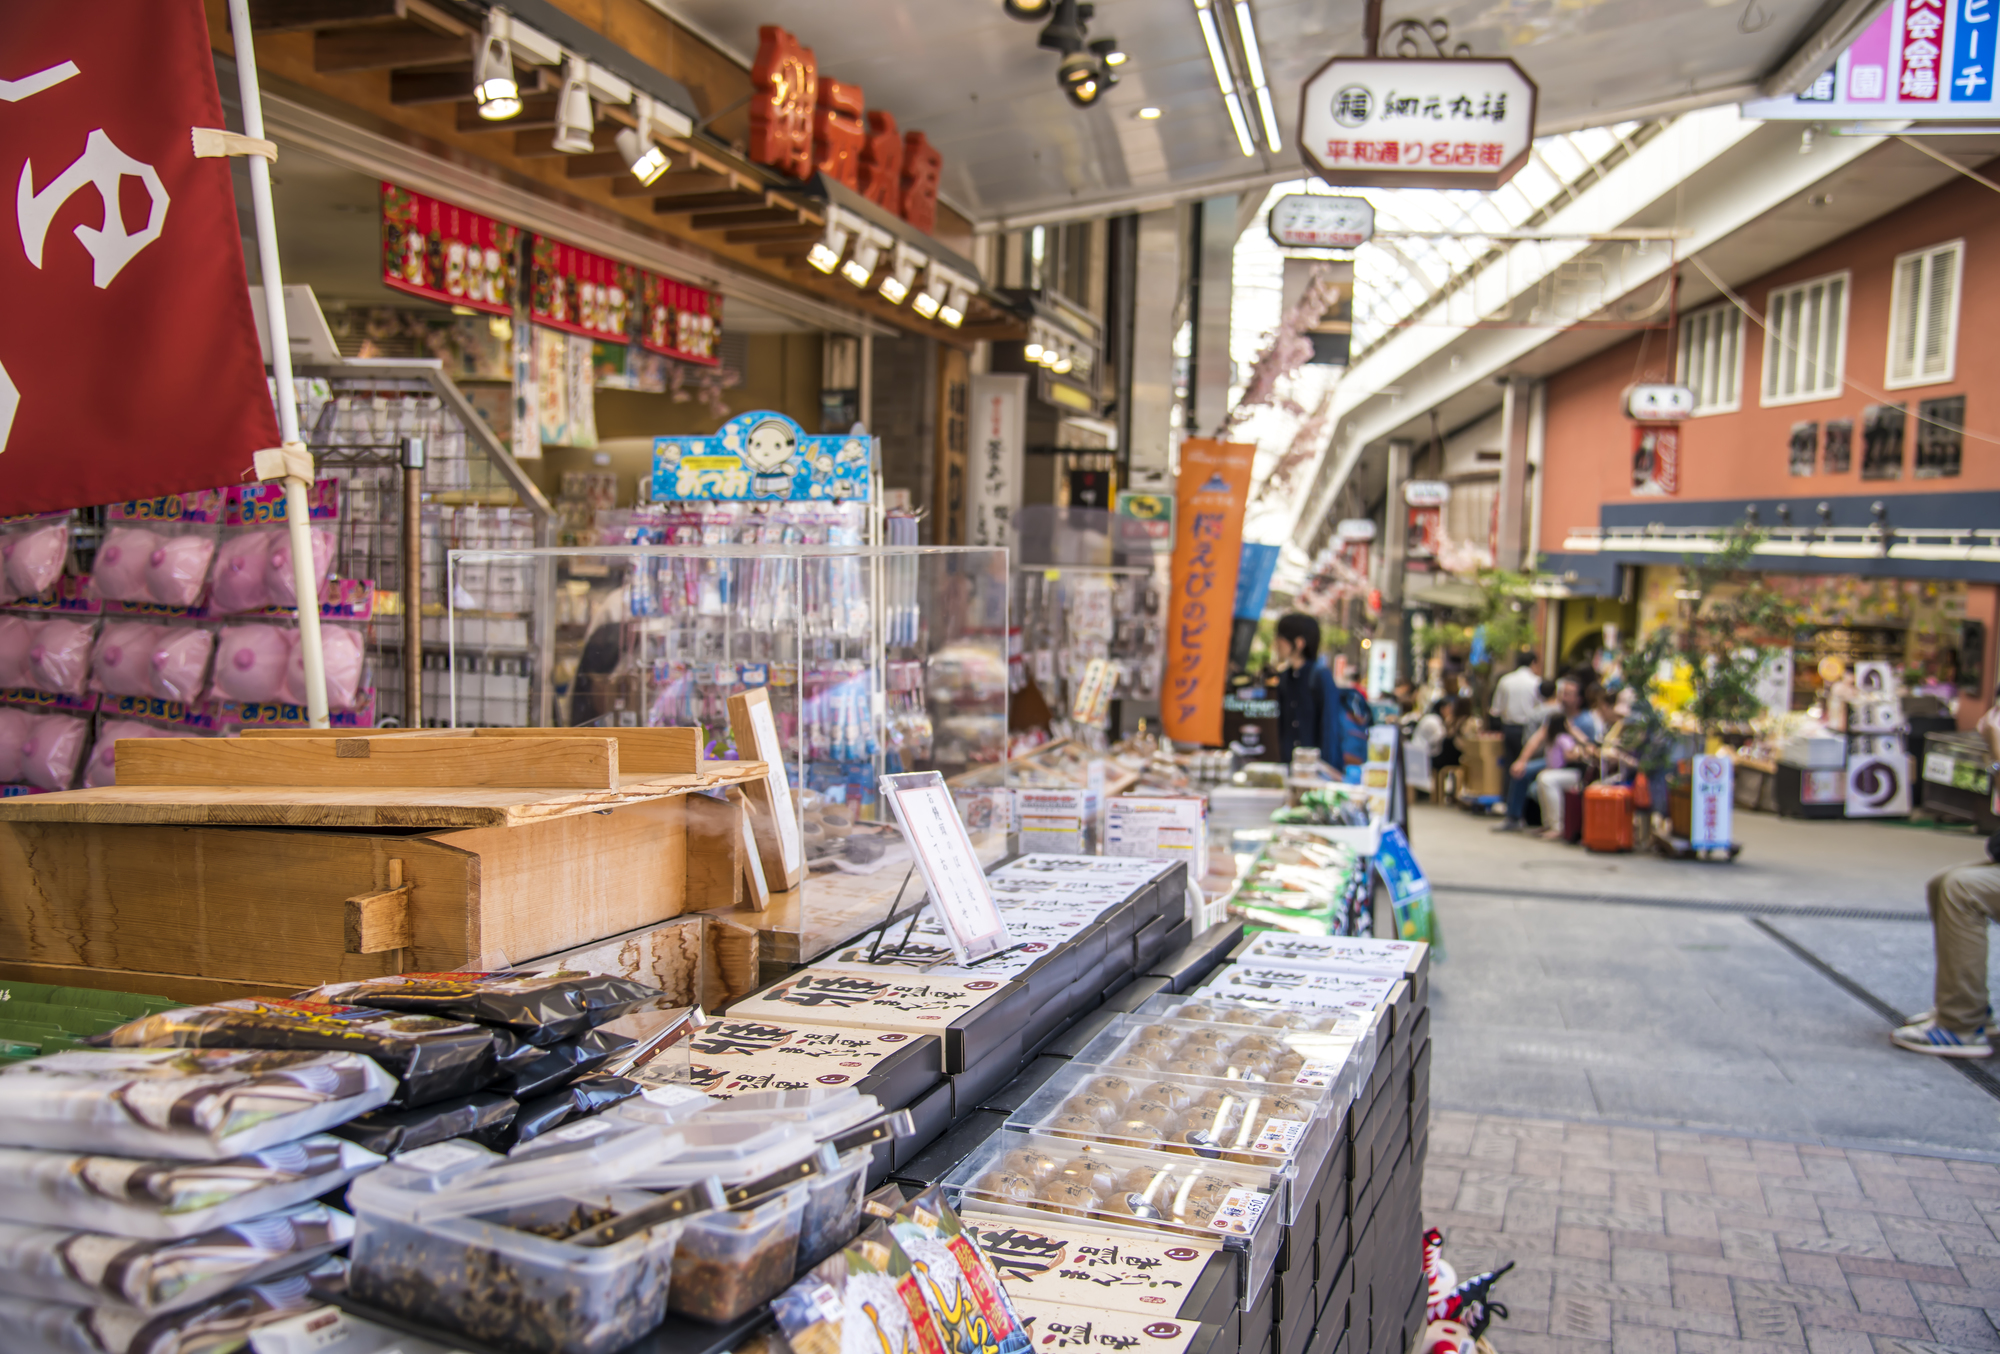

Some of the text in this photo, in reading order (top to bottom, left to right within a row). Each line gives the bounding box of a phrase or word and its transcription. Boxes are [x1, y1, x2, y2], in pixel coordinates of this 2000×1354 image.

[1325, 139, 1504, 165] 平和通り名店街
[242, 498, 289, 523] おっぱ
[1073, 1245, 1163, 1270] 温泉
[955, 1243, 1009, 1336] 駿河湾
[1059, 1268, 1183, 1287] まんじゅう
[1041, 1321, 1141, 1350] 温泉
